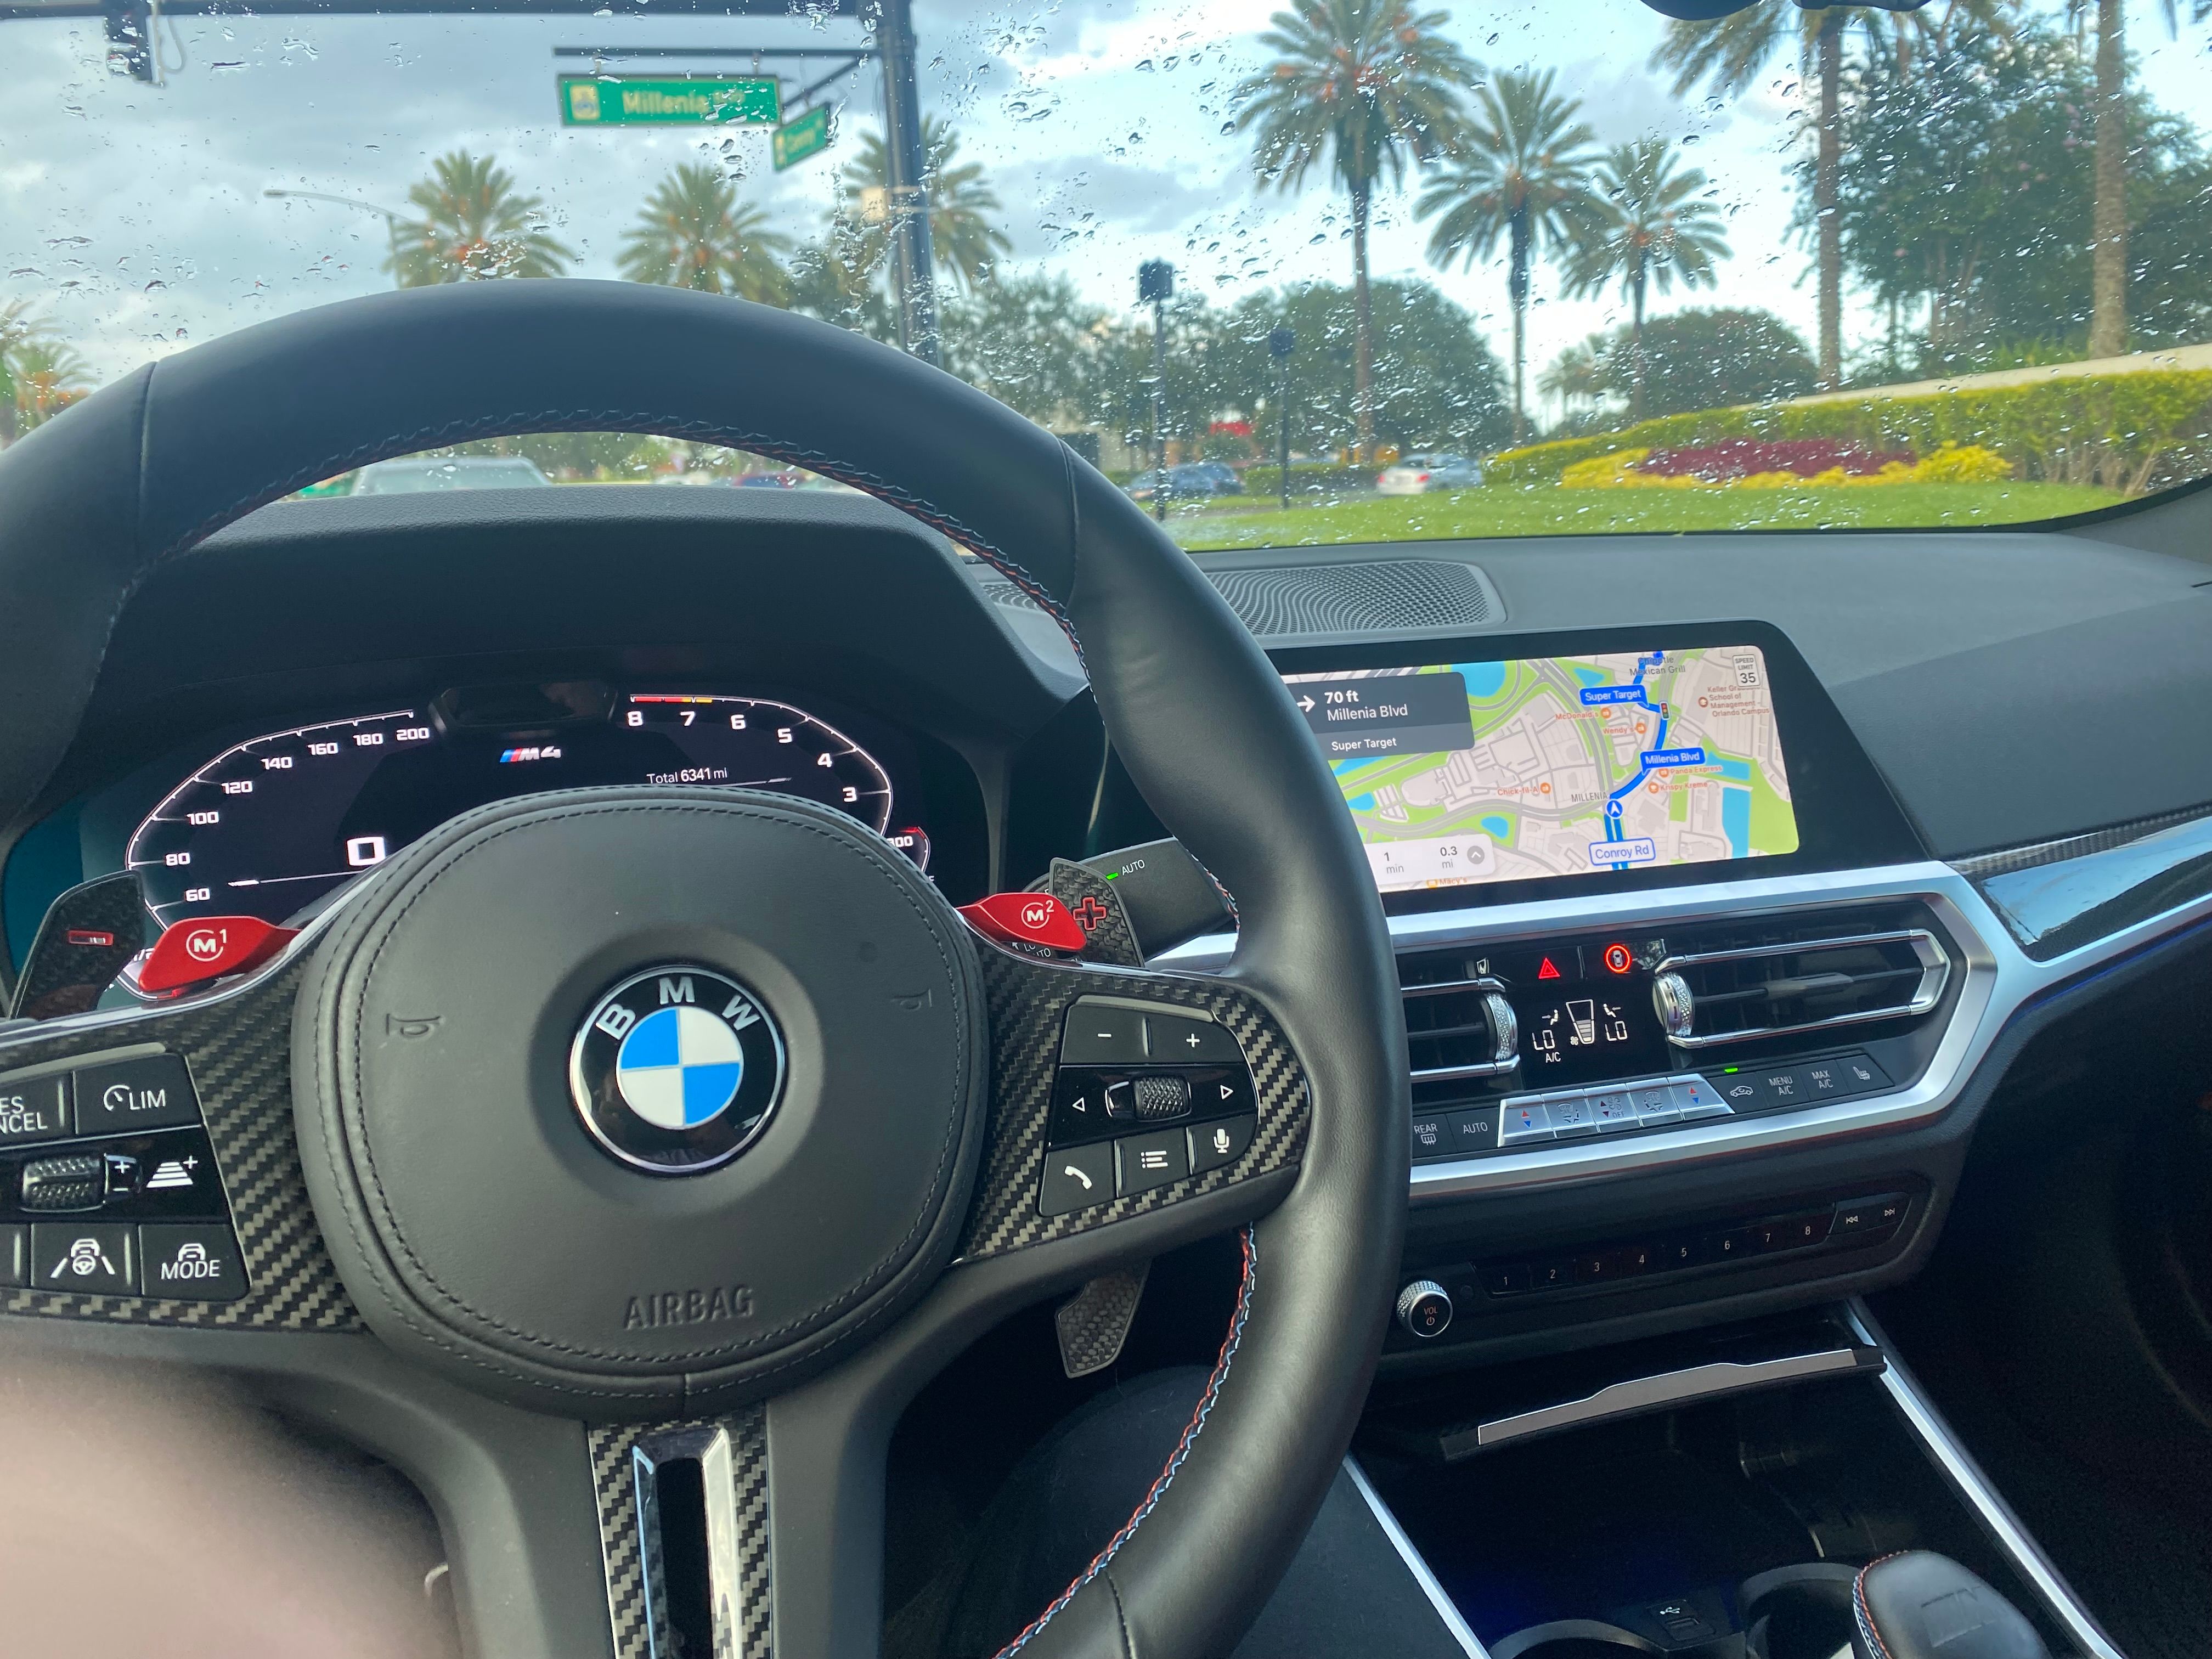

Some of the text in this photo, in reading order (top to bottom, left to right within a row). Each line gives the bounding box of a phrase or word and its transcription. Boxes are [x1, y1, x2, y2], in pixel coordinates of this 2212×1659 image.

[1629, 664, 1686, 676] Mexican Grill
[1740, 673, 1756, 684] 35
[1324, 690, 1359, 704] 70 ft
[1585, 690, 1641, 702] Super Target
[627, 711, 643, 727] 8
[680, 711, 696, 726] 7
[1327, 704, 1408, 721] Millenia Blvd
[731, 714, 746, 730] 6
[353, 733, 383, 746] 180
[396, 727, 430, 741] 200
[777, 728, 792, 744] 5
[308, 742, 338, 755] 160
[1331, 737, 1397, 752] Super Target
[261, 756, 292, 770] 140
[817, 753, 833, 769] 4
[1645, 752, 1700, 764] Millenia Blvd
[646, 771, 678, 784] Total
[680, 768, 711, 782] 6341
[221, 780, 253, 794] 120
[842, 787, 857, 802] 3
[1571, 791, 1608, 803] MILLENIA
[187, 810, 219, 825] 100
[347, 836, 385, 866] 0
[1384, 852, 1390, 861] 1
[1440, 846, 1458, 856] 0.3
[1595, 845, 1649, 859] Conroy Rd
[166, 852, 190, 866] 80
[1442, 859, 1453, 868] mi
[1121, 859, 1146, 876] AUTO
[1386, 864, 1404, 874] min
[1439, 877, 1467, 885] Macy's
[184, 888, 210, 901] 60
[596, 976, 760, 1040] BMW
[1605, 1020, 1628, 1042] LO
[1532, 1030, 1555, 1050] LO
[1545, 1051, 1561, 1063] A/C
[1769, 1075, 1793, 1086] MENU
[1812, 1070, 1830, 1079] MAX
[1779, 1085, 1793, 1096] A/C
[1819, 1079, 1833, 1089] A/C
[128, 1088, 166, 1111] LIM
[1414, 1122, 1438, 1135] REAR
[1463, 1122, 1488, 1135] AUTO
[1805, 1226, 1811, 1235] 8
[1765, 1233, 1770, 1243] 7
[1724, 1240, 1730, 1250] 6
[1639, 1254, 1645, 1264] 4
[1681, 1248, 1687, 1257] 5
[160, 1259, 221, 1279] MODE
[1594, 1262, 1600, 1272] 3
[1504, 1276, 1508, 1285] 1
[1550, 1269, 1556, 1279] 2
[623, 1284, 754, 1330] AIRBAG
[1423, 1306, 1438, 1315] VOL
